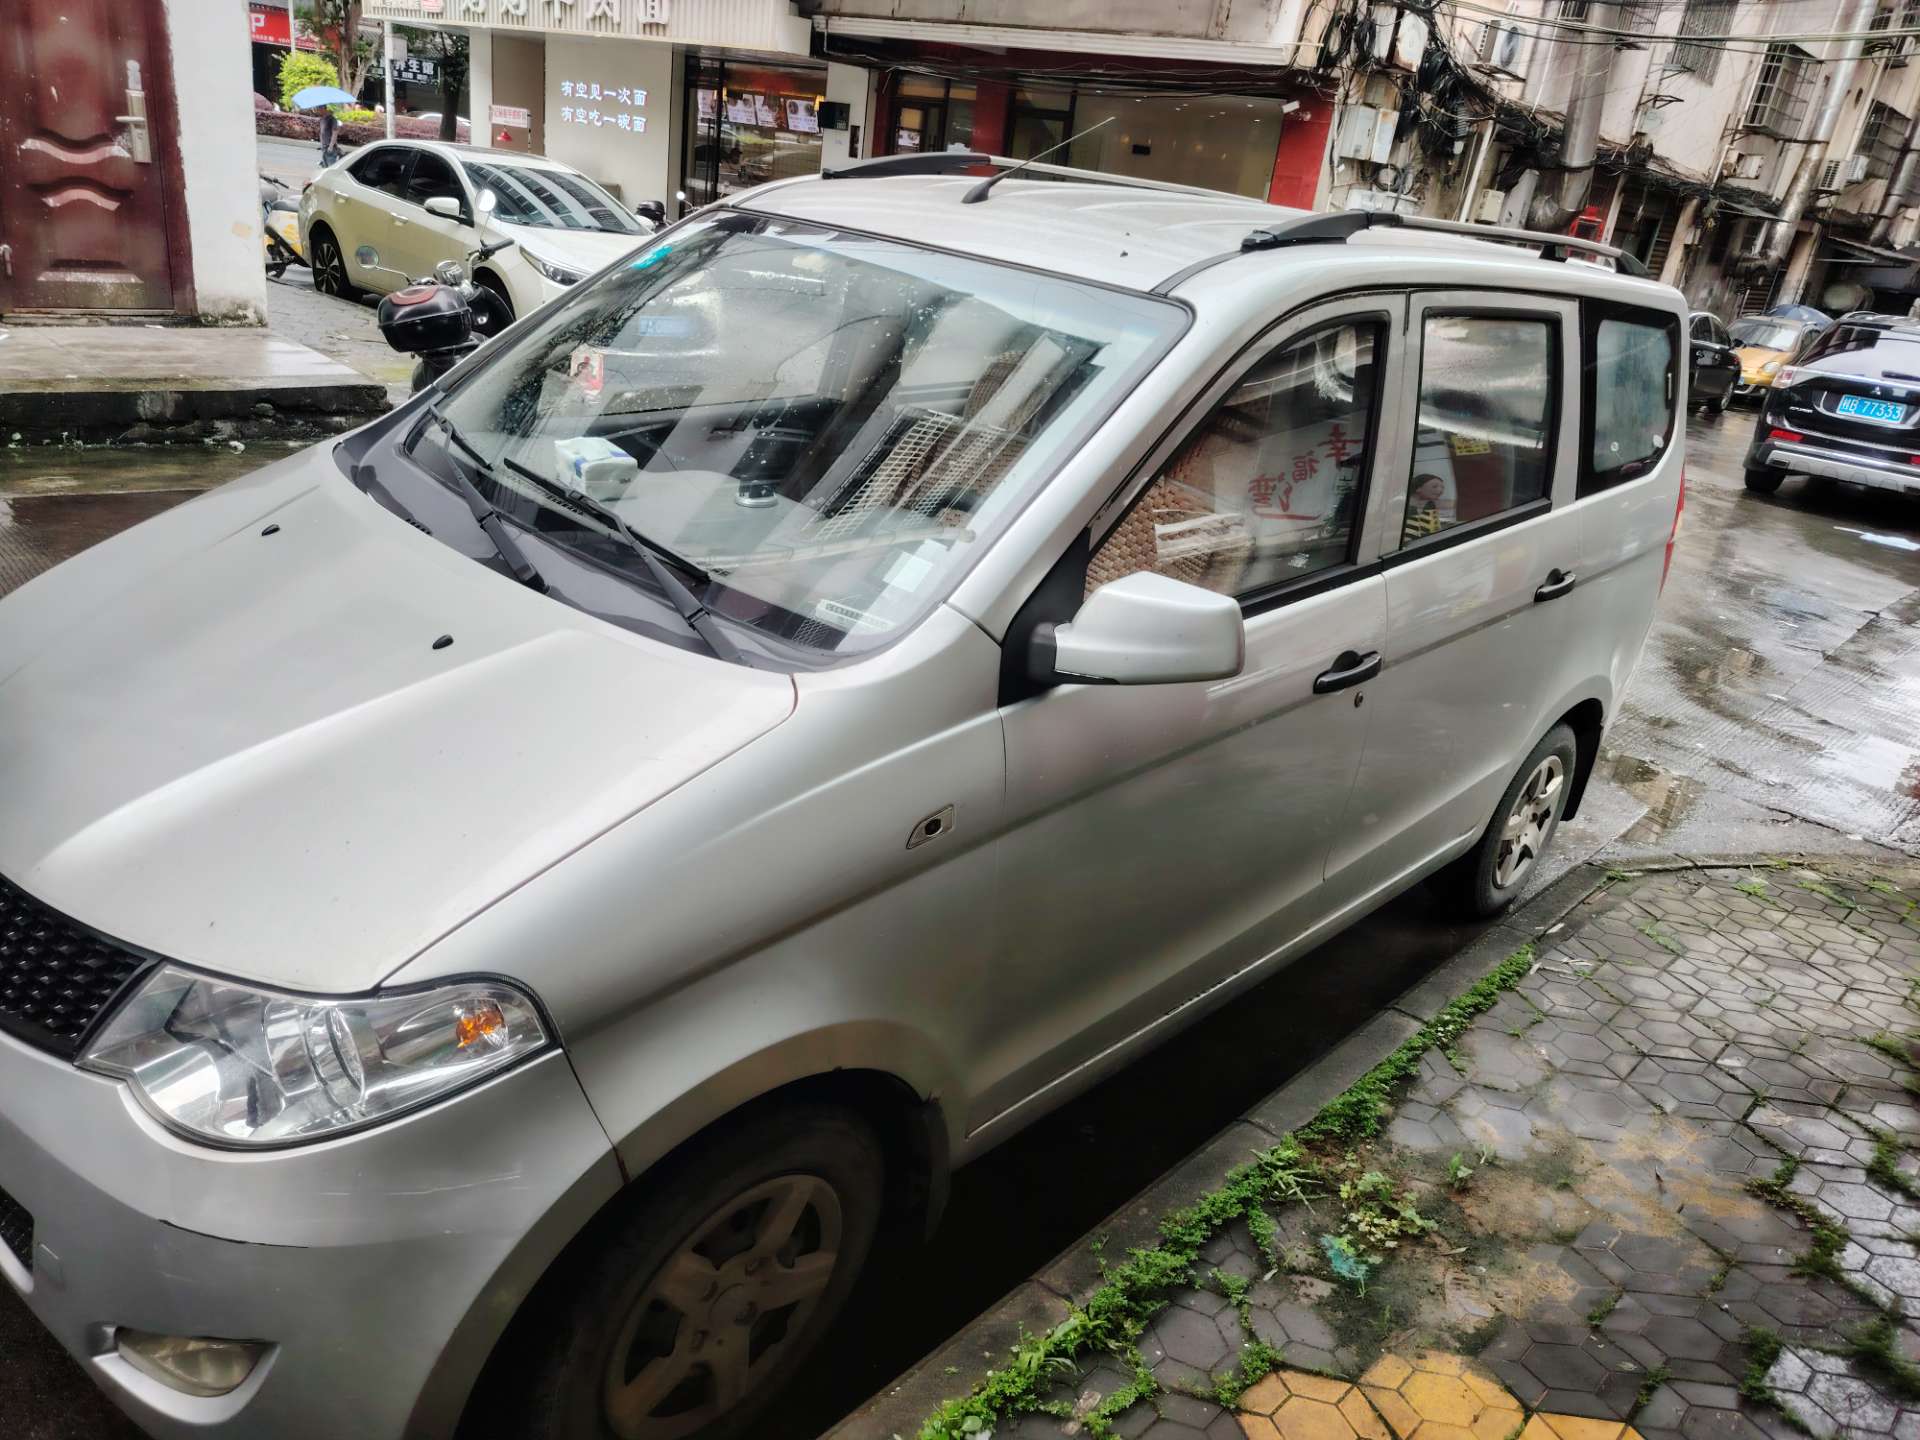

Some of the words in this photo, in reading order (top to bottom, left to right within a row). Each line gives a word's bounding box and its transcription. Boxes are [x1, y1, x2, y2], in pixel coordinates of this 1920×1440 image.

[561, 80, 647, 106] 有空见一次面
[561, 106, 647, 133] 有空吃一碗面
